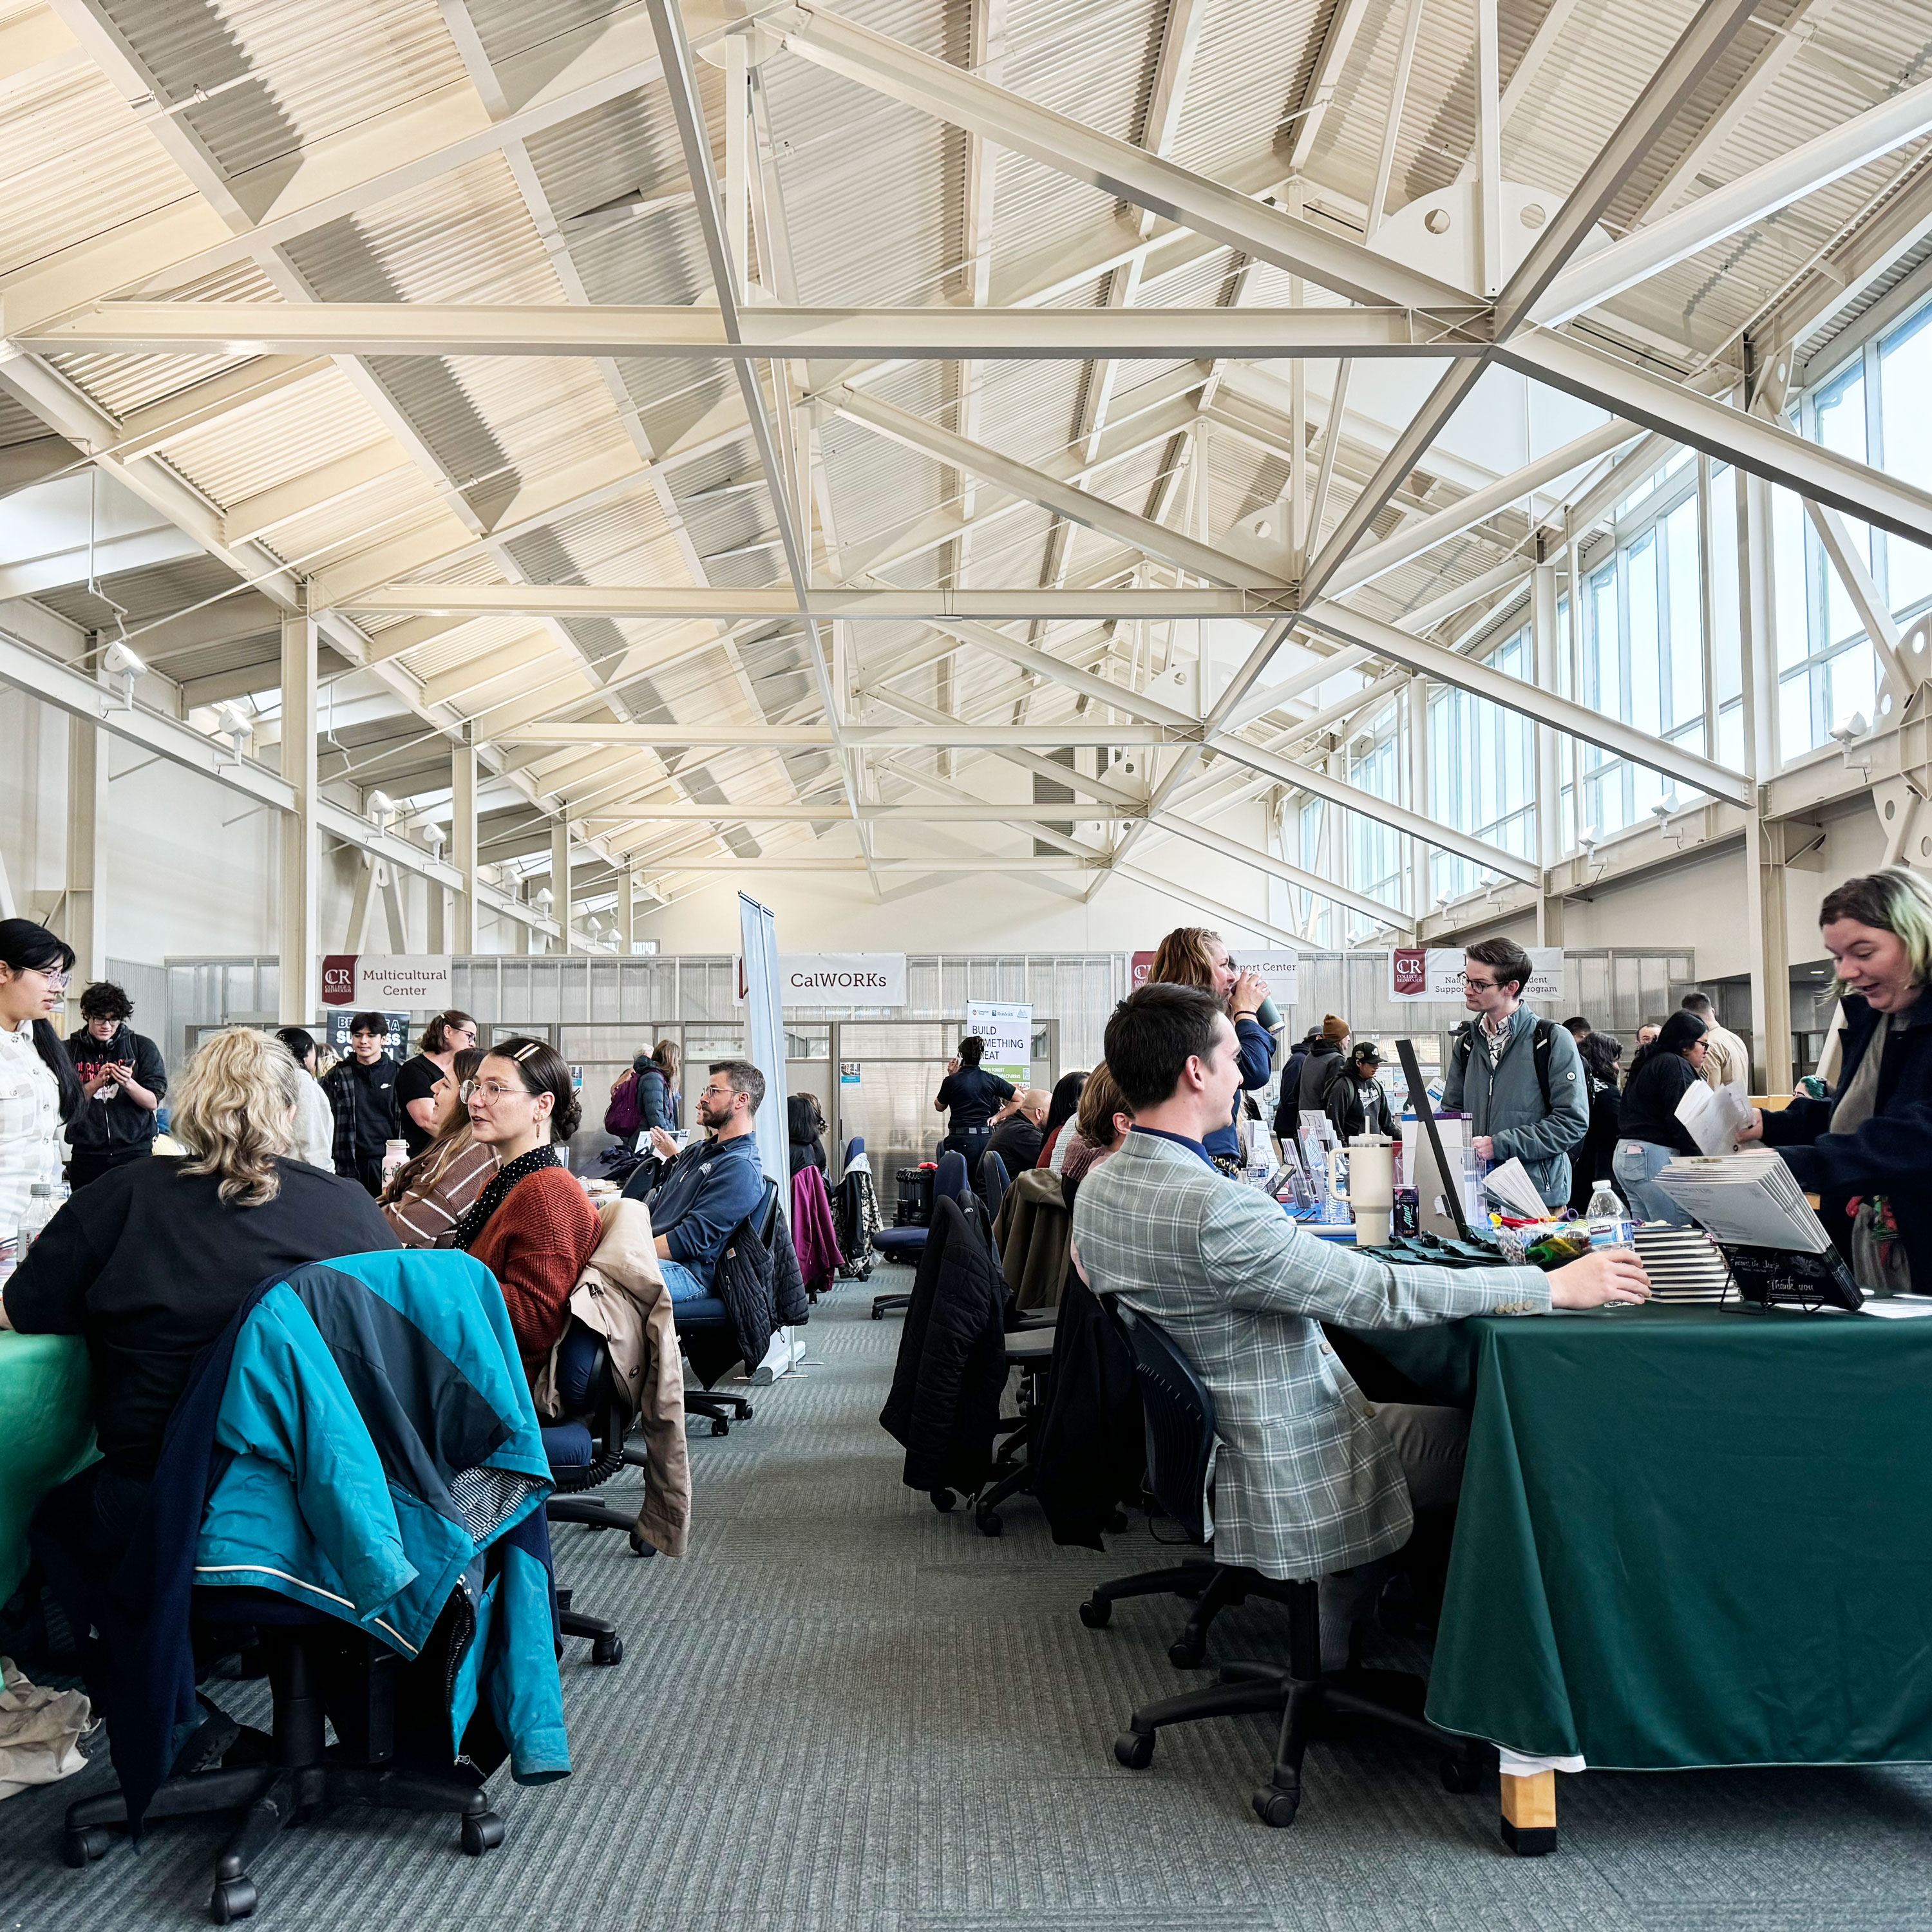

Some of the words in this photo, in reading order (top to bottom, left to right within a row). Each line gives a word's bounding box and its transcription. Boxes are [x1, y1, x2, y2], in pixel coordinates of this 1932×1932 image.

[1263, 963, 1296, 971] Center
[1396, 959, 1422, 974] CR
[325, 969, 352, 984] CR
[363, 970, 447, 980] Multicultural
[791, 973, 887, 987] CalWORKs
[383, 985, 426, 996] Center
[972, 1025, 997, 1035] BUILD
[984, 1038, 1024, 1048] METHING
[1771, 1275, 1795, 1291] Thank
